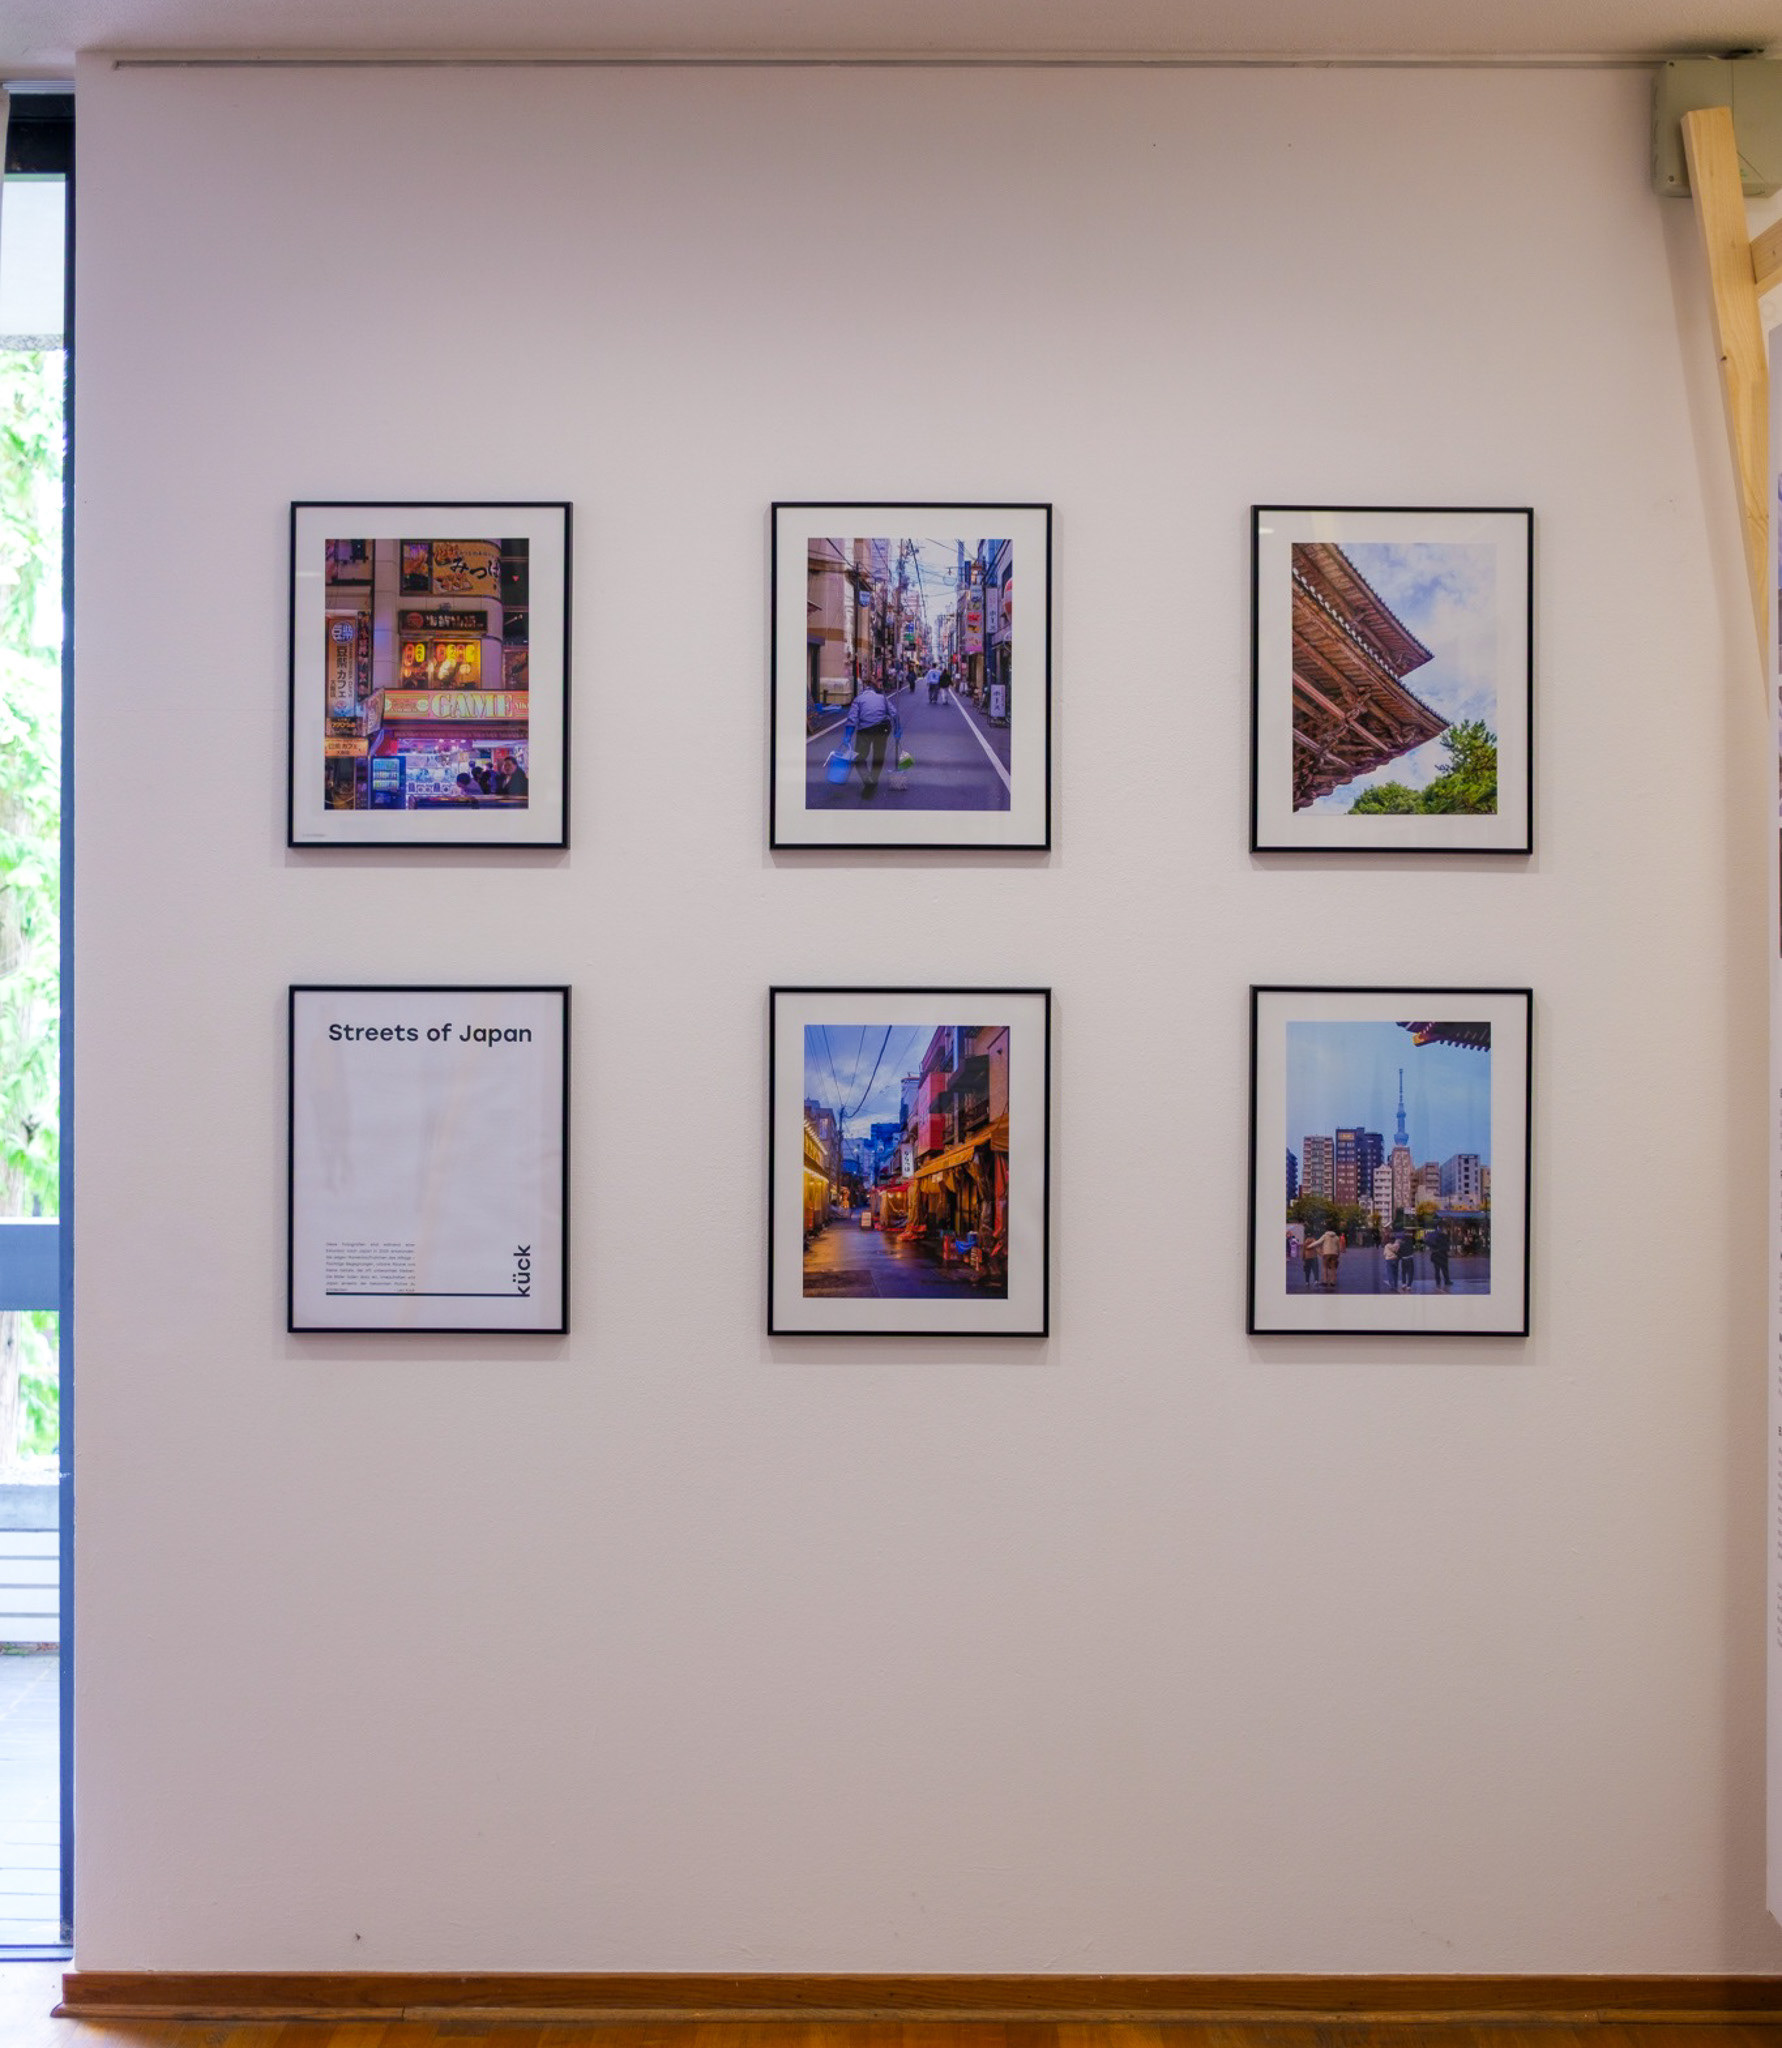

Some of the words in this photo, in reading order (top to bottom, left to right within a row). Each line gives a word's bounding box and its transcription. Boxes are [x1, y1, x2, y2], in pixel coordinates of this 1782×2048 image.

[431, 693, 512, 718] GAME
[328, 1023, 419, 1042] Streets
[427, 1023, 453, 1042] of
[459, 1024, 532, 1047] Japan
[513, 1244, 531, 1298] kück
